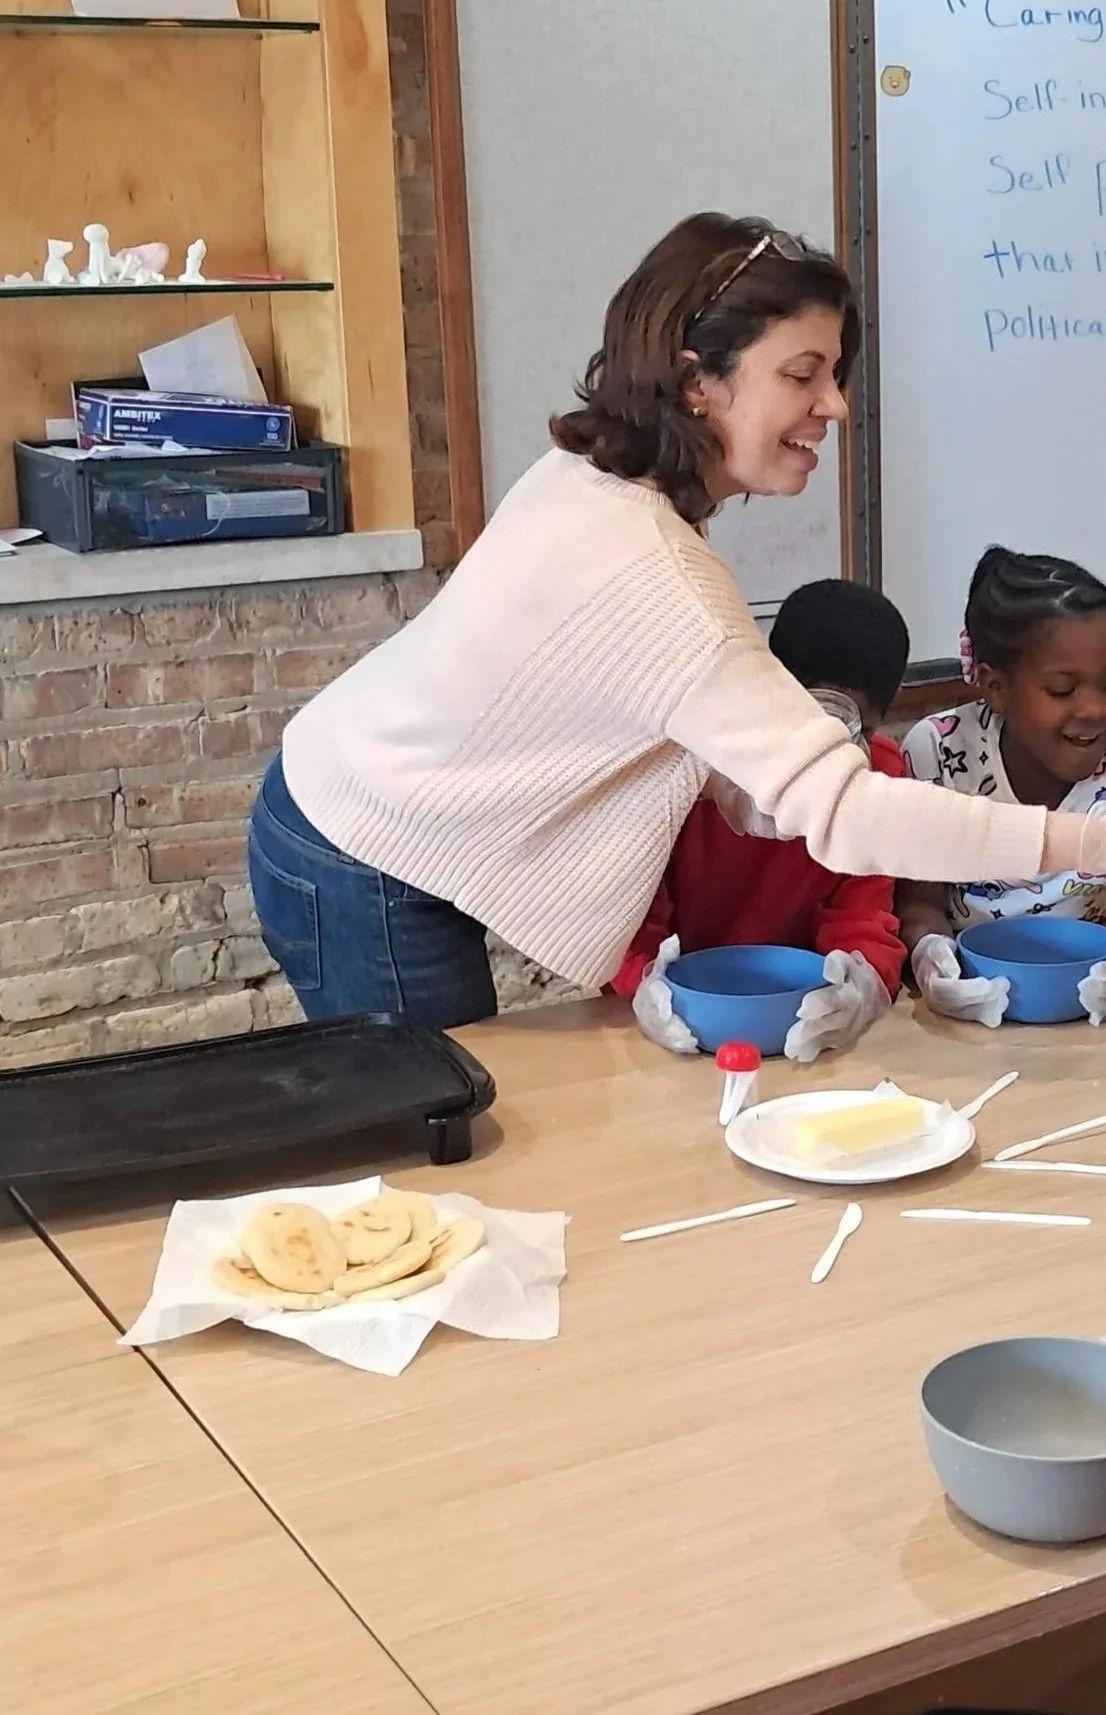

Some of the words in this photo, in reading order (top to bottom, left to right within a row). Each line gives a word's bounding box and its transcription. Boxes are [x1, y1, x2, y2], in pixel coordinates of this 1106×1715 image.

[986, 153, 1071, 194] Self
[983, 239, 1075, 280] that
[113, 408, 162, 422] AMBITEX
